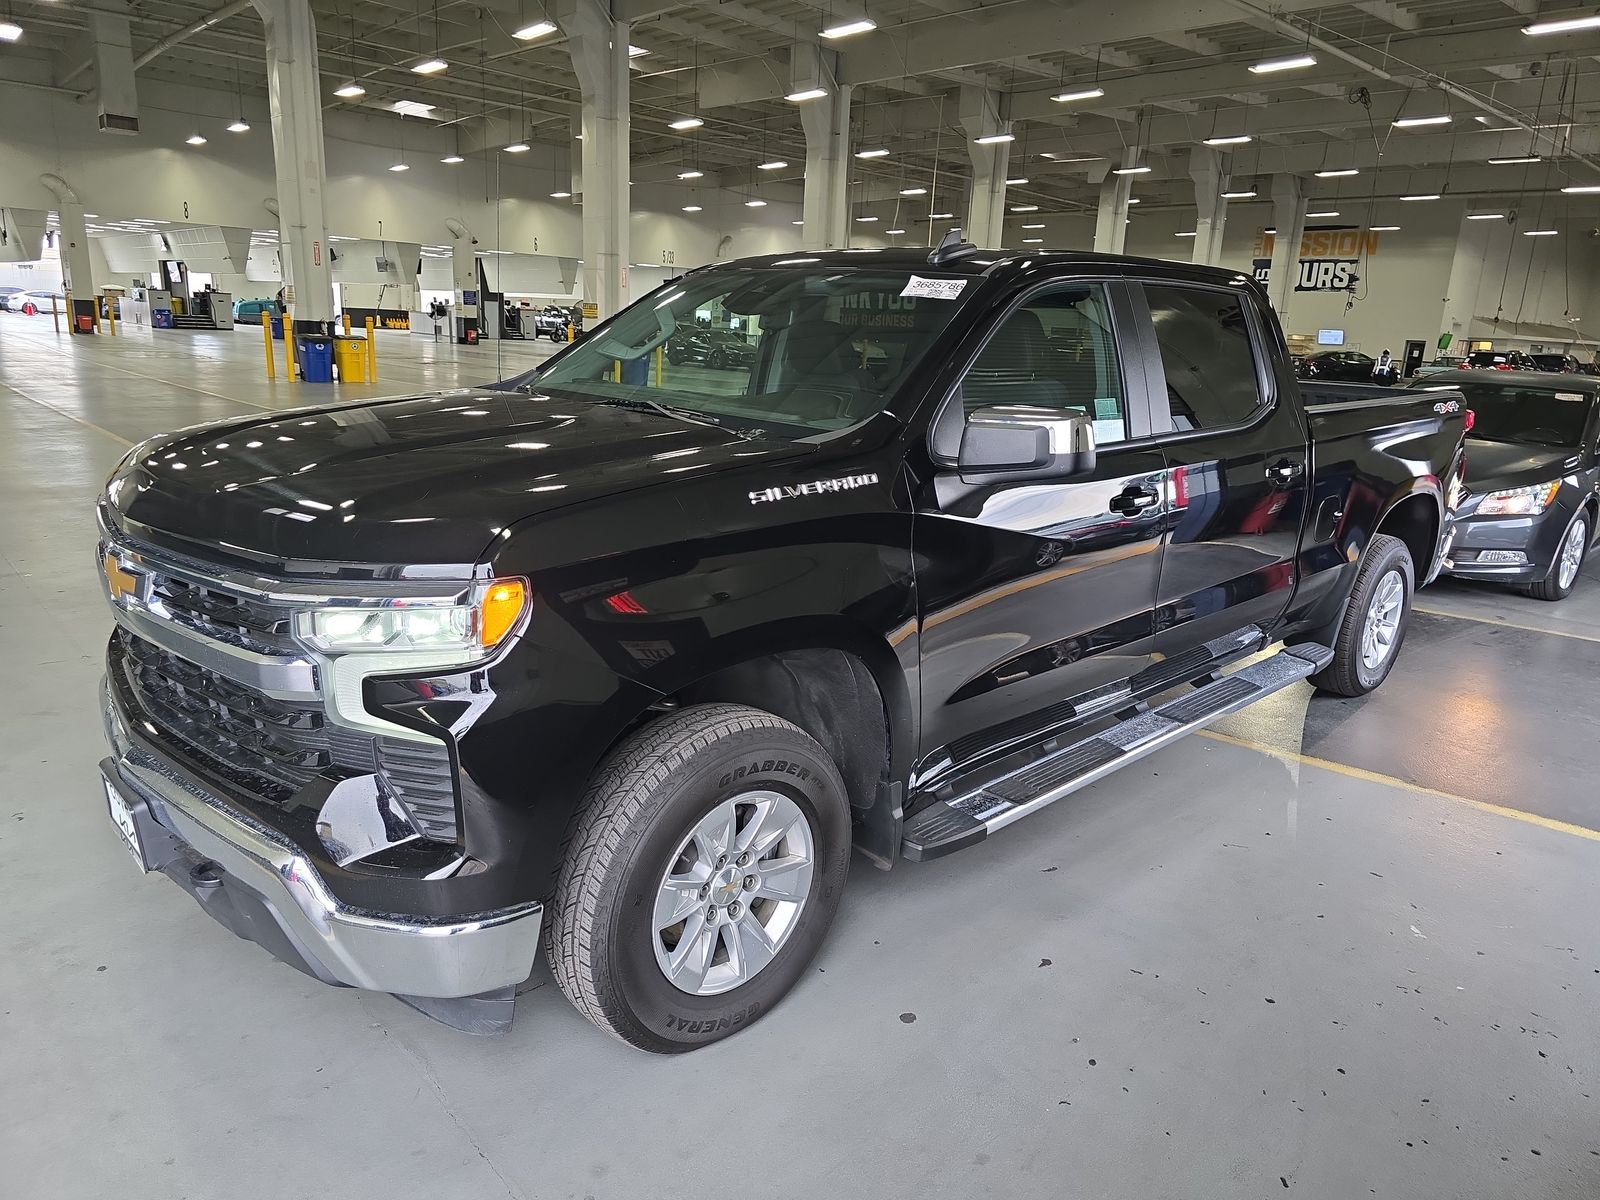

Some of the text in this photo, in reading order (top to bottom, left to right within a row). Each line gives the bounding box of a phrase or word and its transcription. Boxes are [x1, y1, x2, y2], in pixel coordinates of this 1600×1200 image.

[183, 201, 189, 219] 8
[912, 280, 965, 291] 3685786
[1296, 262, 1350, 288] URS
[861, 313, 915, 328] BUSINESS
[748, 472, 879, 505] SILVERADO
[718, 760, 811, 788] GRABBER
[666, 1002, 761, 1034] GENERAL
